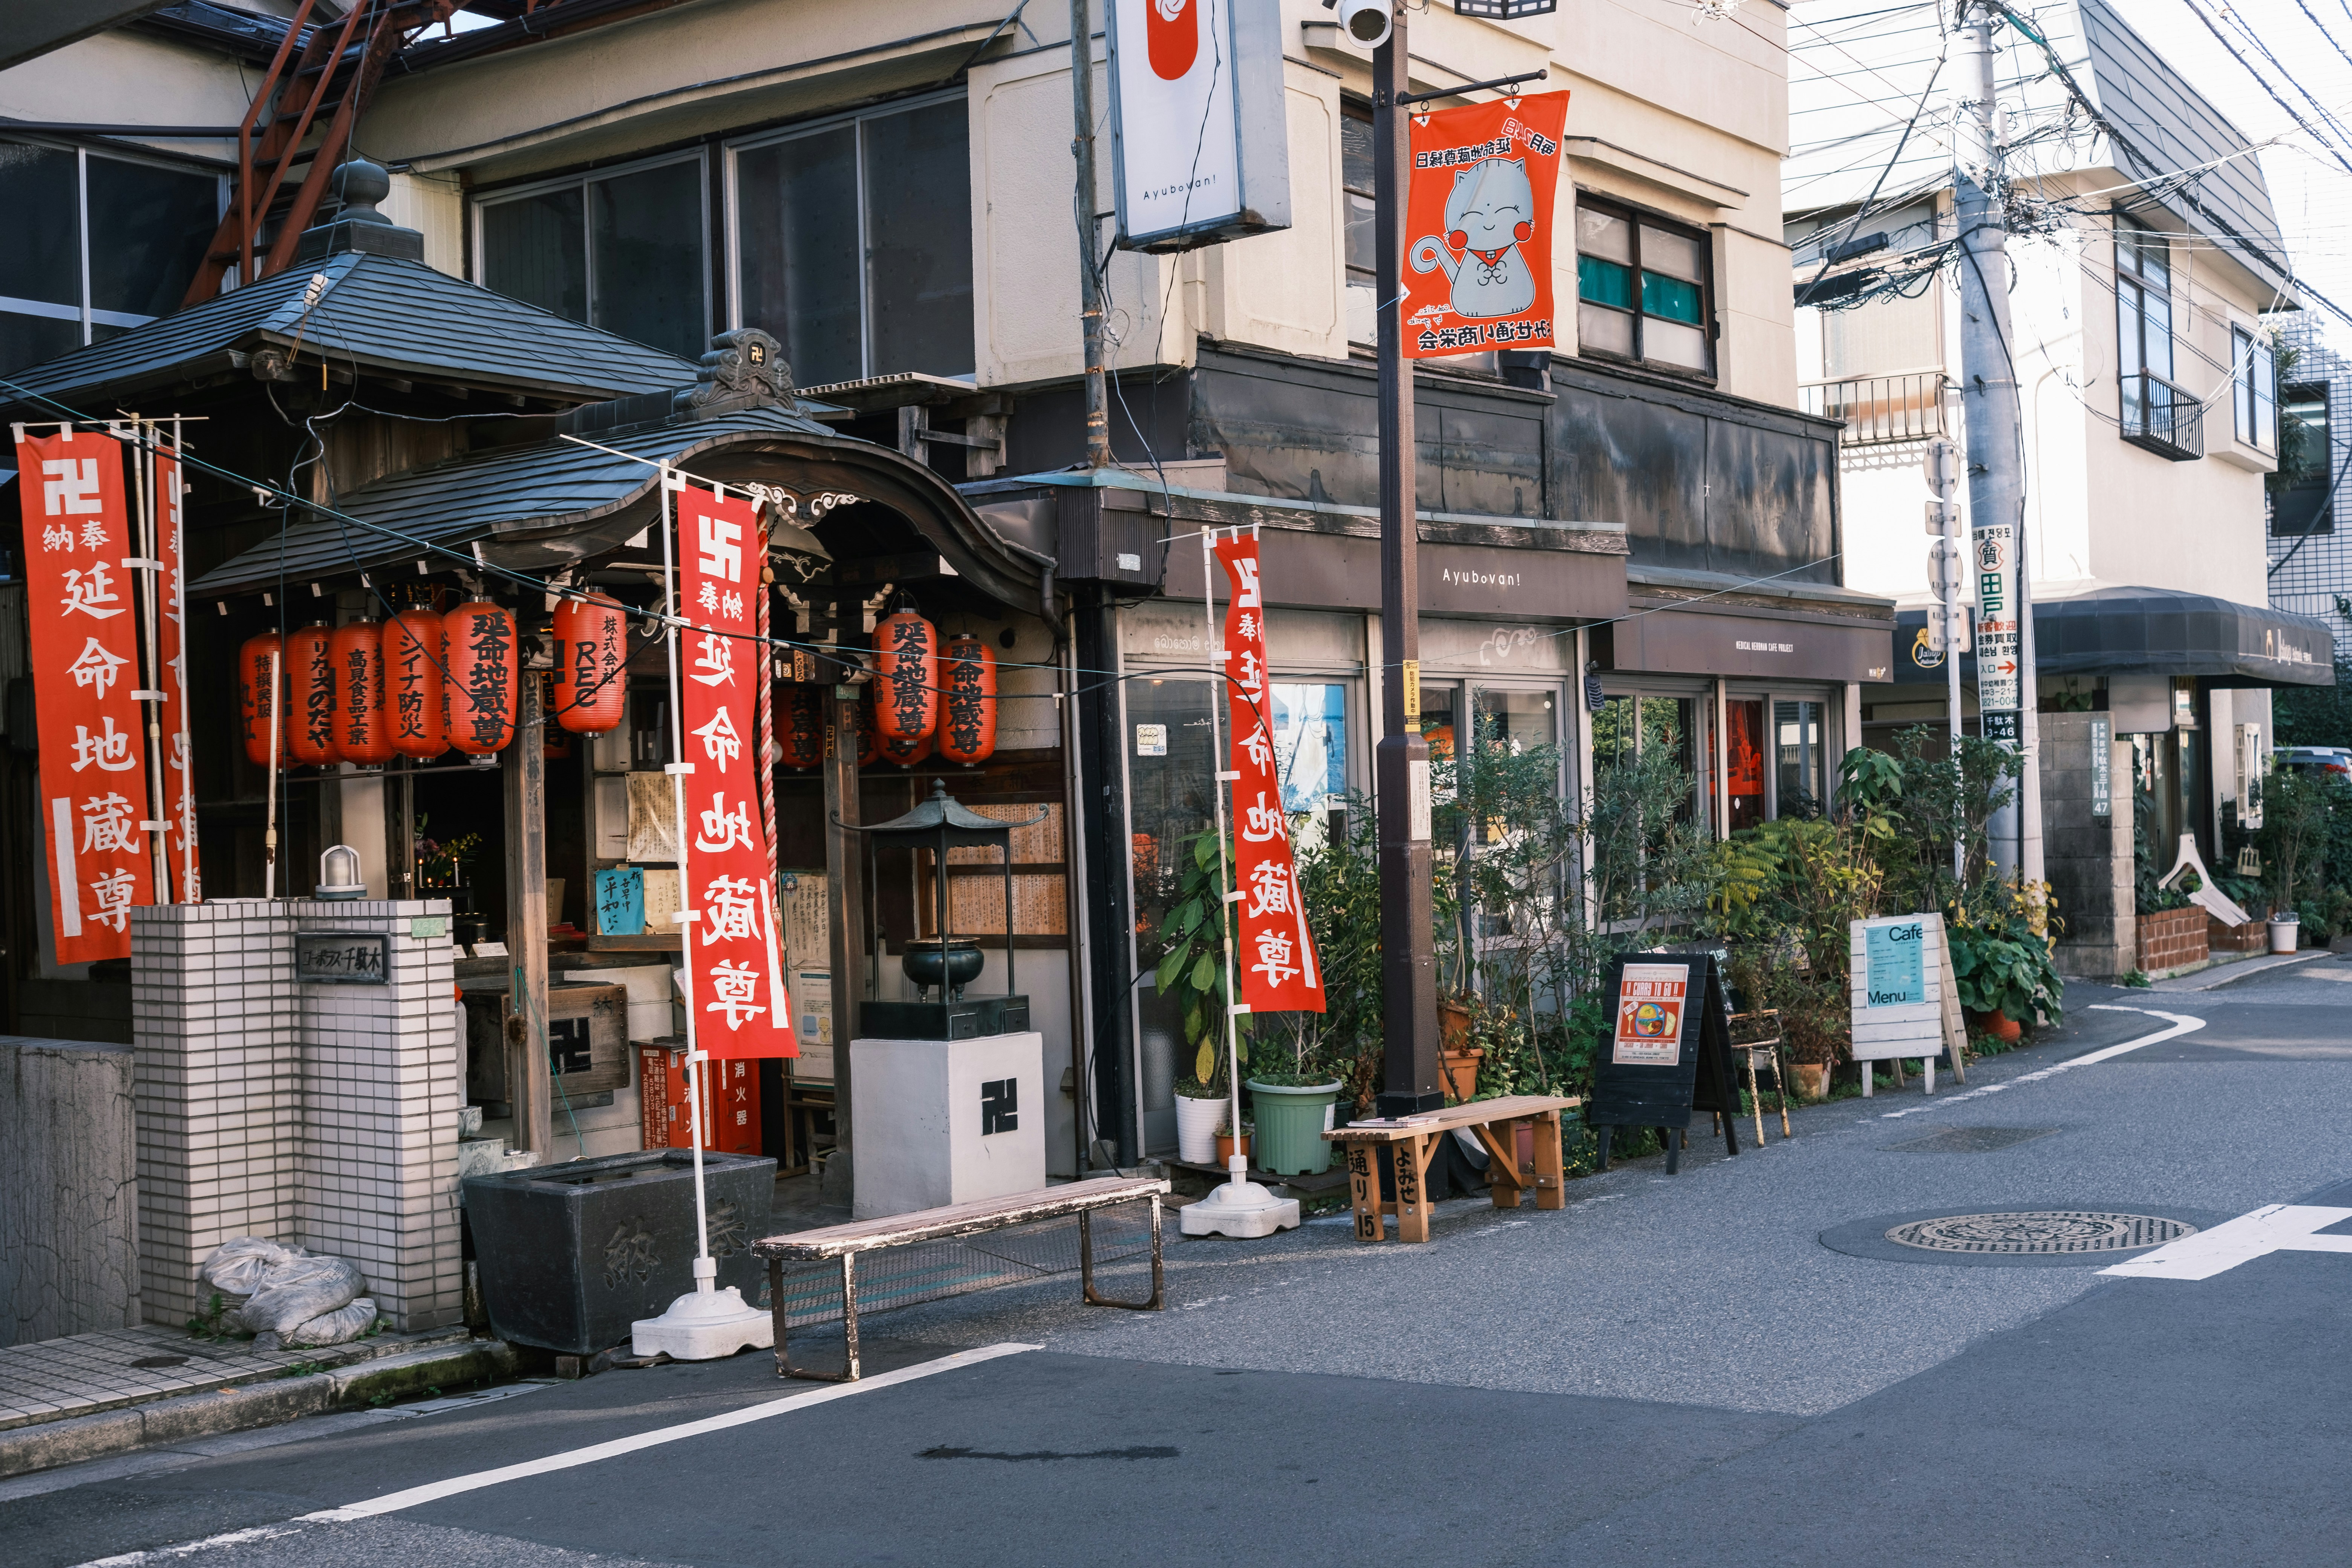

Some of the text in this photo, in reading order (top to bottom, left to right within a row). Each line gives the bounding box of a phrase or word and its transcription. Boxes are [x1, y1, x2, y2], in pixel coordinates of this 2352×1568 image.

[1144, 175, 1216, 200] Ayubovan!
[1983, 547, 1997, 565] 質
[1443, 568, 1521, 586] Ayubovan!
[601, 616, 618, 684] 株式会社
[1736, 641, 1751, 650] MEDICAL
[1769, 643, 1777, 652] CAFE
[1778, 643, 1793, 652] PROJECT
[467, 611, 511, 747] 延命地蔵尊
[574, 641, 597, 707] REC
[891, 621, 927, 736] 延命地蔵尊
[1981, 665, 1995, 674] 入口
[347, 648, 368, 745] 高見食品工業
[398, 635, 427, 738] シイナ防災
[838, 688, 858, 696] 46-9
[947, 644, 985, 754] 延命地蔵尊
[1987, 716, 2014, 725] 千駄木
[1988, 727, 2014, 737] 3-46
[60, 560, 140, 934] 延命地蔵尊
[2095, 802, 2108, 813] 47
[415, 922, 443, 934] 46-9
[1889, 925, 1923, 941] Cafe
[1633, 982, 1652, 995] CURRY
[1654, 983, 1661, 996] TO
[1663, 983, 1672, 996] GO
[1868, 991, 1906, 1005] Menu
[735, 1062, 747, 1125] 消火器
[1396, 1147, 1416, 1205] よみせ
[1348, 1149, 1375, 1237] 通り 15
